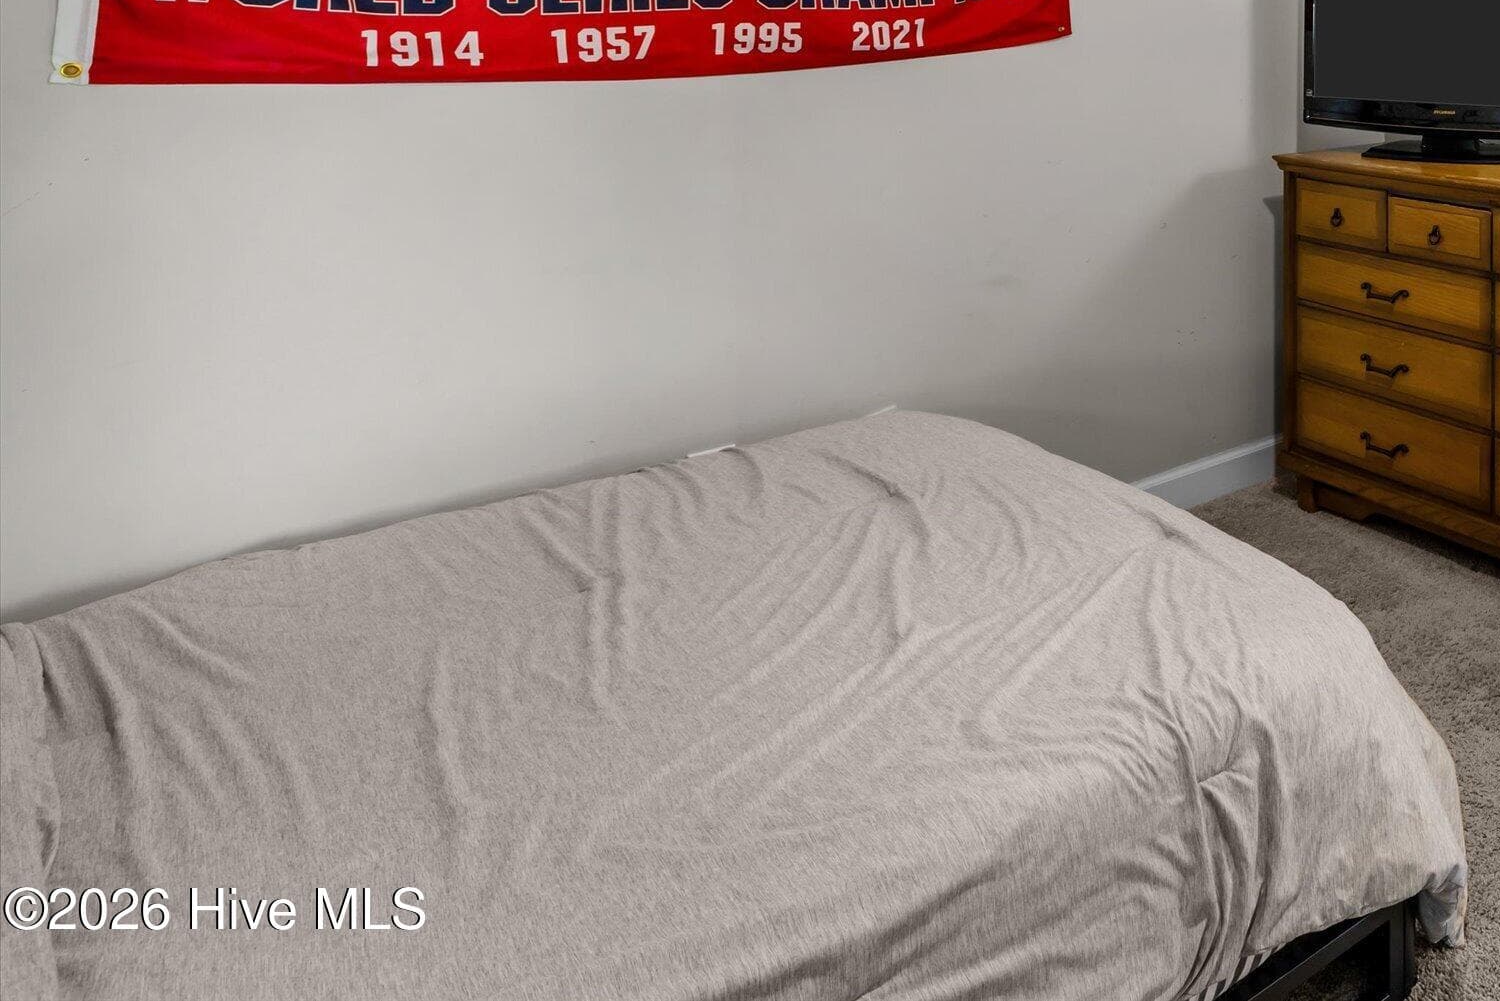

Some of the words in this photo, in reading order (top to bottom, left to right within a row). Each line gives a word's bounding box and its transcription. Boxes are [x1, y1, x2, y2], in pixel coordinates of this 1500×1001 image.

[361, 29, 484, 67] 1914
[550, 25, 656, 64] 1957
[711, 22, 802, 55] 1995
[852, 18, 925, 52] 2021
